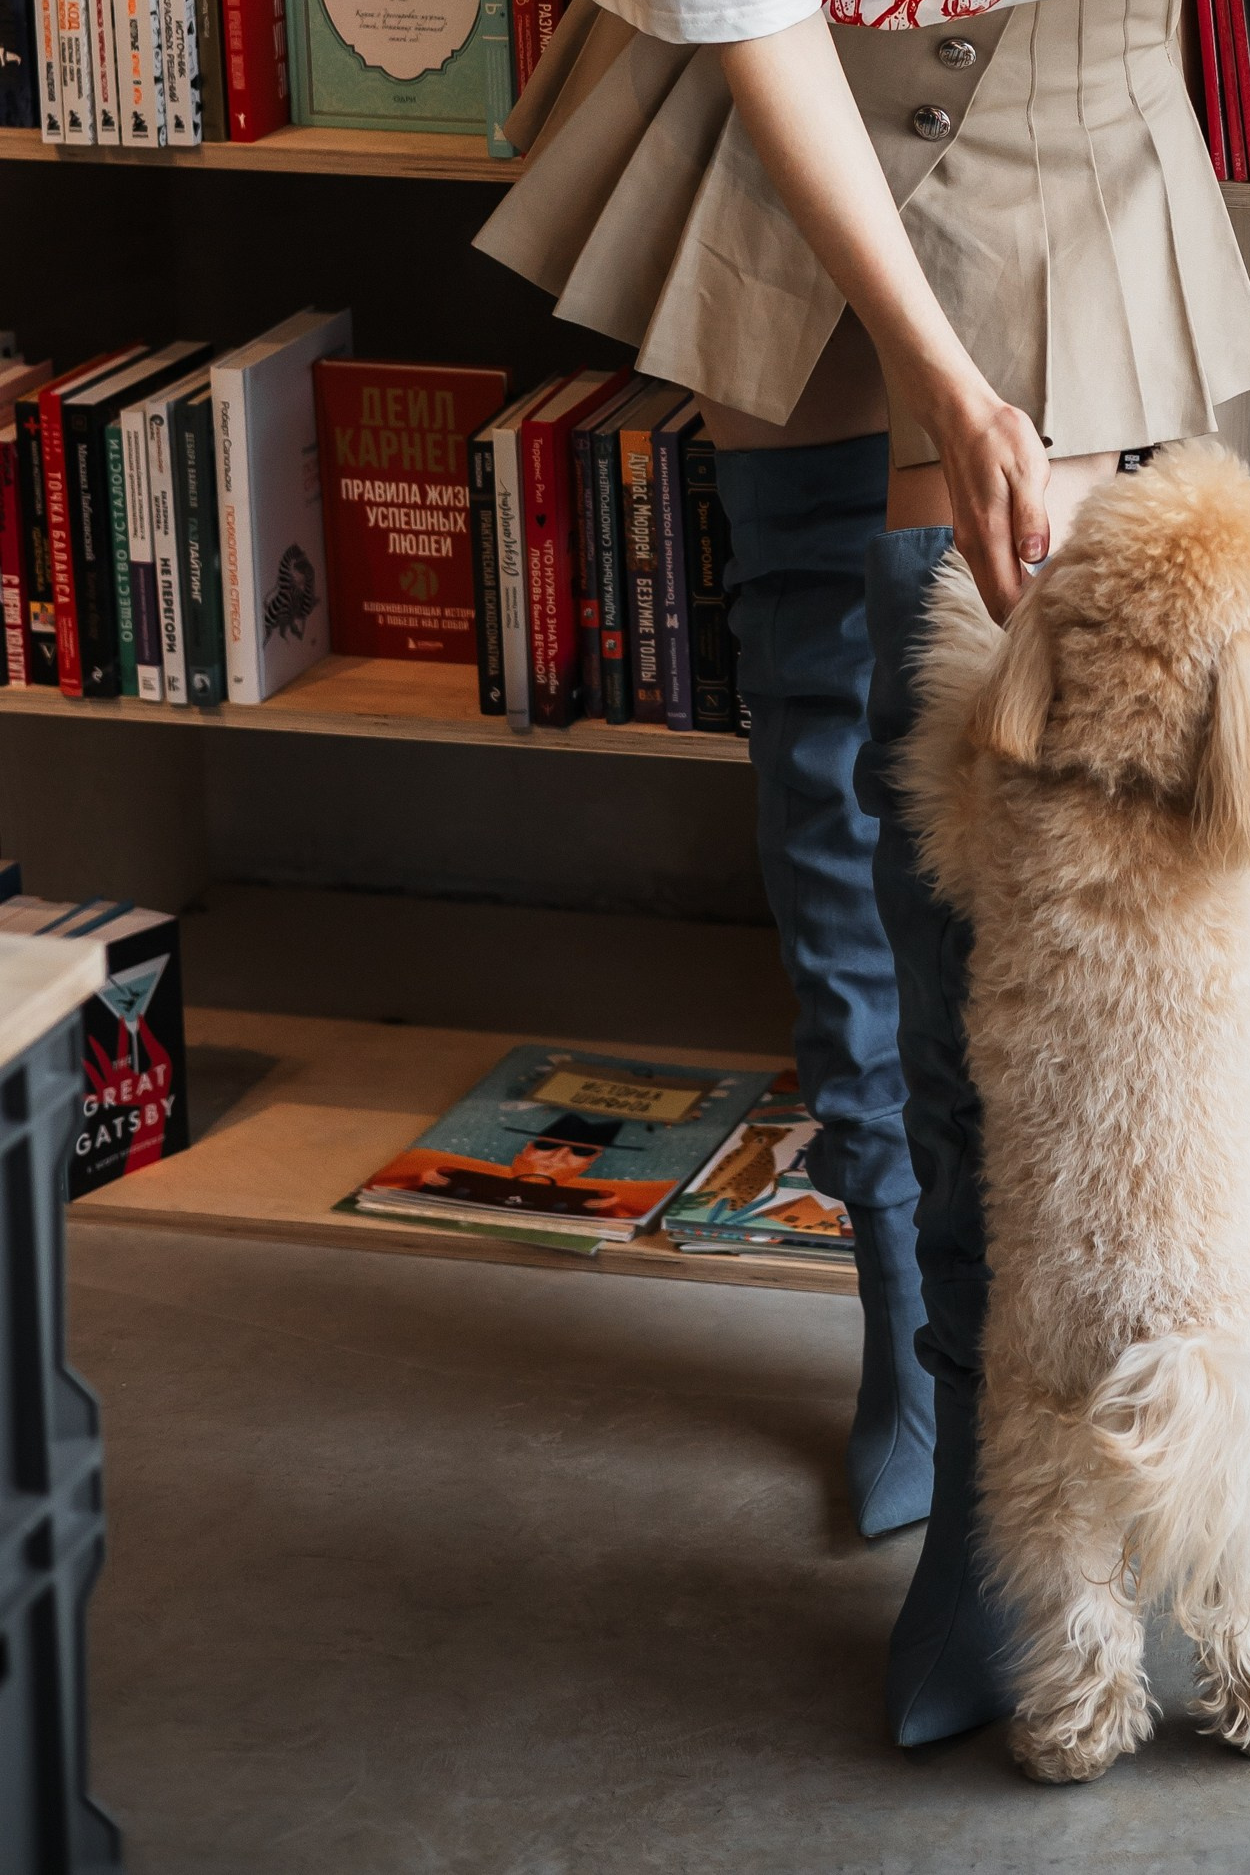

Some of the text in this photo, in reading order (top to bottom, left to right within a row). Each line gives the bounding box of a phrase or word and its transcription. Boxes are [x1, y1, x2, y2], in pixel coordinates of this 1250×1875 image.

[359, 385, 456, 430] ДЕЙЛ
[340, 478, 420, 506] ПРАВИЛА
[532, 437, 546, 504] Терренс Рил
[627, 451, 649, 501] Дуглас
[47, 471, 71, 605] ТОЧКА БАЛАНСА
[107, 438, 134, 643] ОБЩЕСТВО УСТАЛОСТИ
[365, 506, 467, 534] УСПЕШНЫХ
[388, 532, 453, 558] ЛЮДЕЙ
[598, 458, 617, 626] РАДИКАЛЬНОЕ САМОПРОЩЕНИЕ
[659, 447, 675, 607] Токсичные родственники
[160, 557, 177, 653] НЕ ПЕРЕГОРИ
[636, 578, 657, 683] БЕЗУМИЕ ТОЛПЫ
[83, 1063, 168, 1118] GREAT
[75, 1094, 176, 1156] GATSBY
